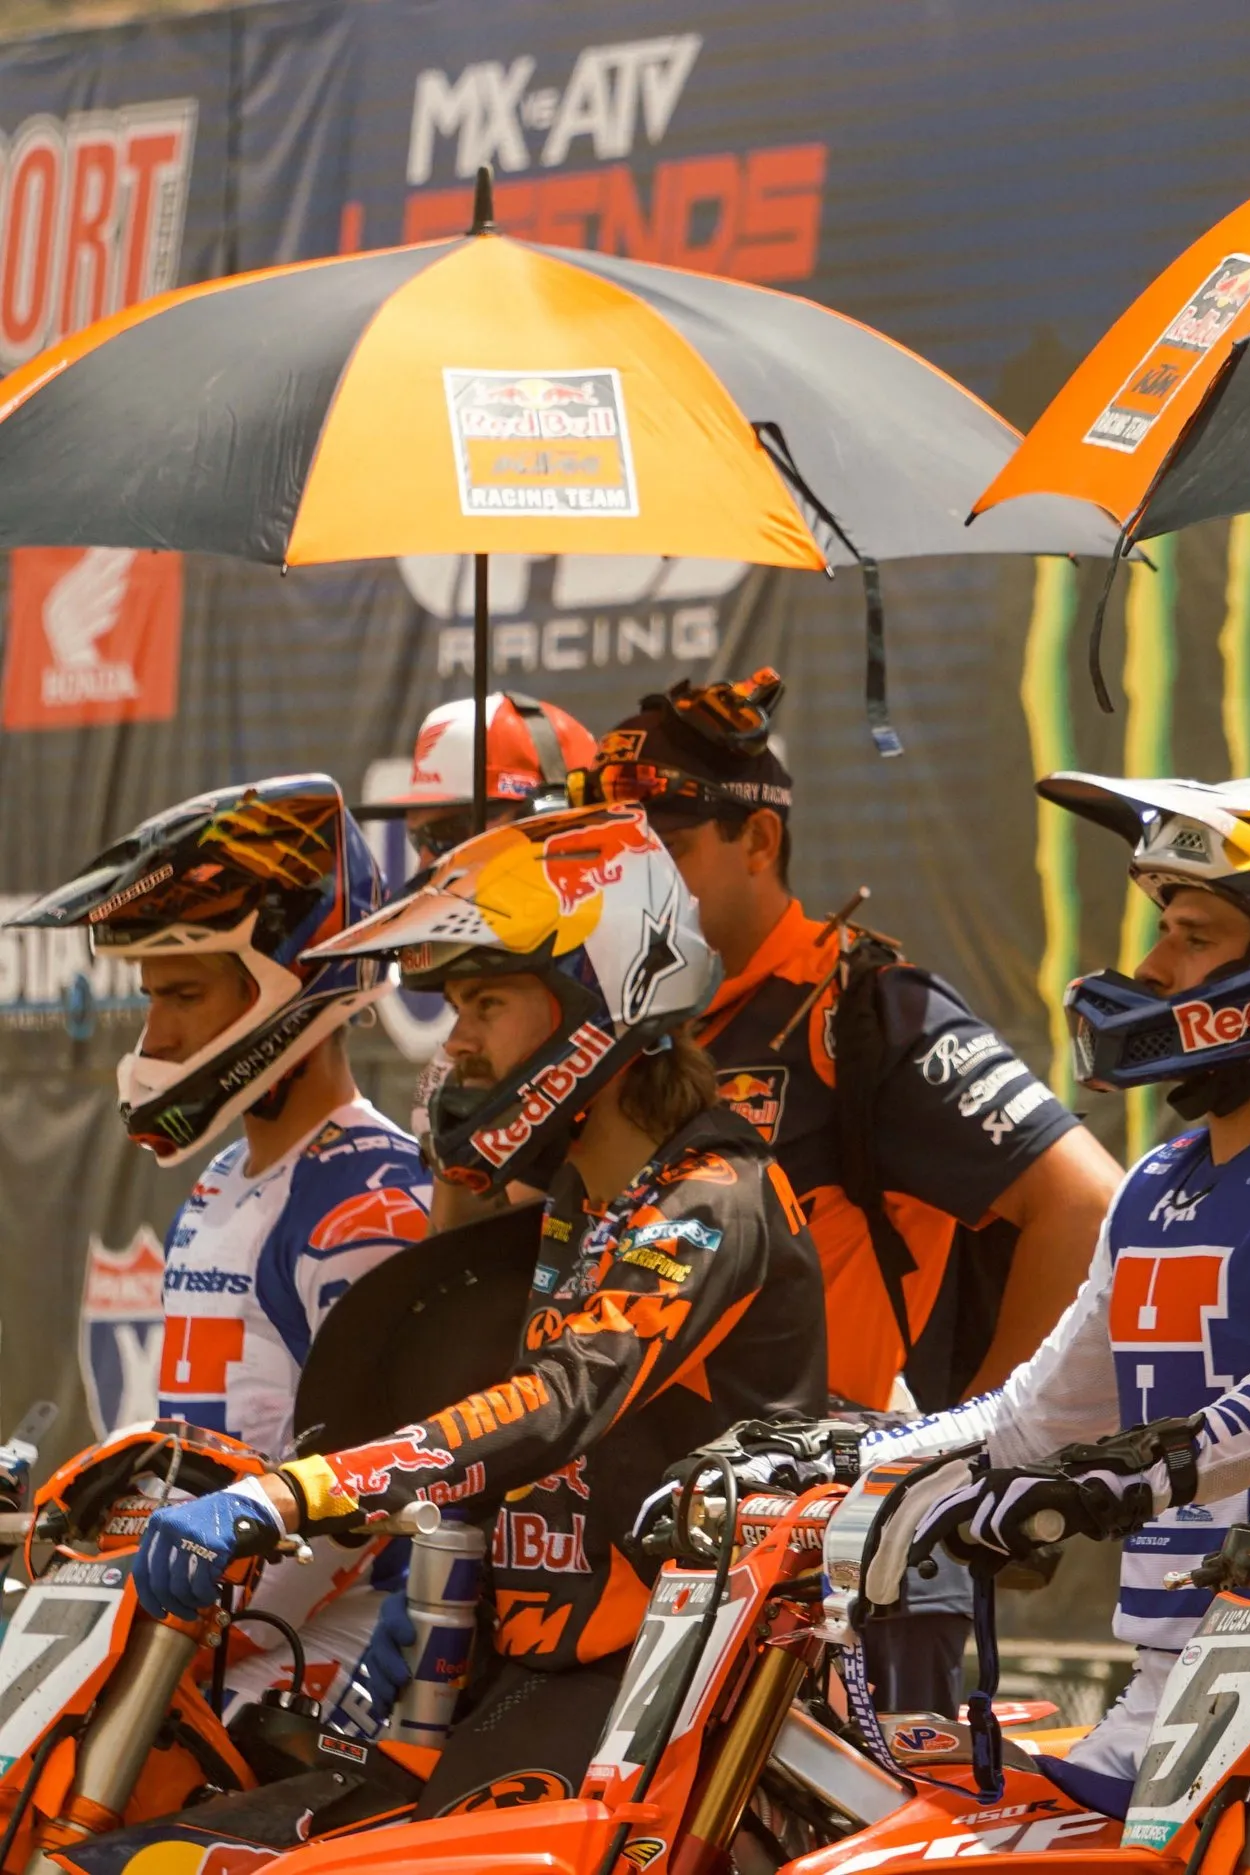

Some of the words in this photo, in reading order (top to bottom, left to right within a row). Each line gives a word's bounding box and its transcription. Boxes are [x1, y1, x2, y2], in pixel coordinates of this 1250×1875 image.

[340, 142, 827, 281] ENDS
[471, 488, 558, 508] RACING
[565, 488, 626, 508] TEAM
[437, 607, 718, 677] RACING
[470, 1083, 556, 1168] Red
[531, 1020, 616, 1105] Bull
[428, 1374, 550, 1450] THOR
[741, 1496, 839, 1518] RENTAL
[181, 1538, 218, 1562] THOR
[741, 1524, 825, 1550] REHA
[952, 1799, 1058, 1825] 450R
